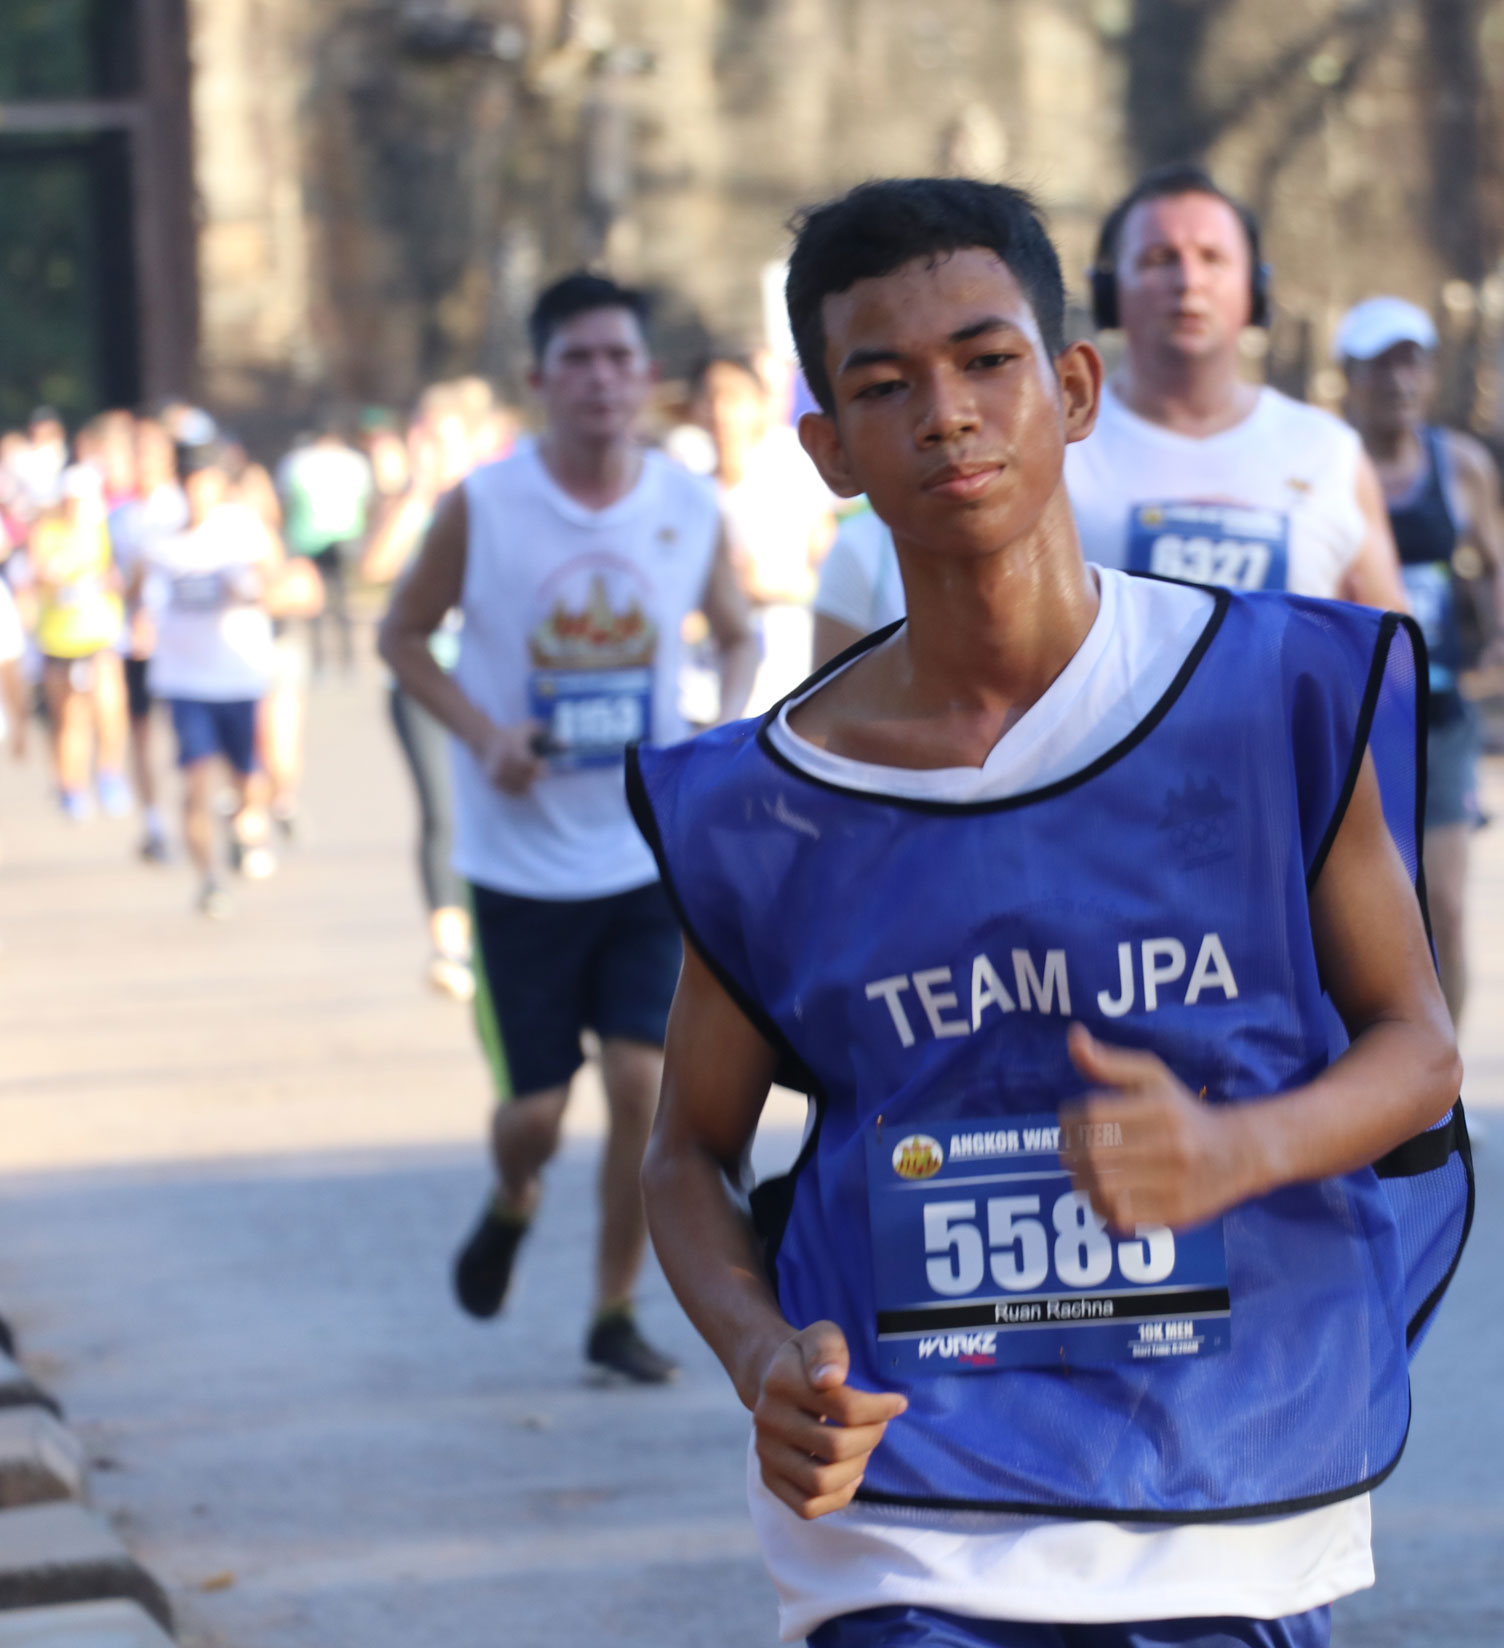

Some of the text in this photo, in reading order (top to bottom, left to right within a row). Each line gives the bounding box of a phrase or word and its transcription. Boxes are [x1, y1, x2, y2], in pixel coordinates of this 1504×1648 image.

[1152, 534, 1271, 590] 6327
[865, 933, 1238, 1048] TEAM JPA
[949, 1129, 1019, 1159] ANGKOR
[1022, 1126, 1061, 1151] WAT
[1138, 1320, 1193, 1343] 10K MEN
